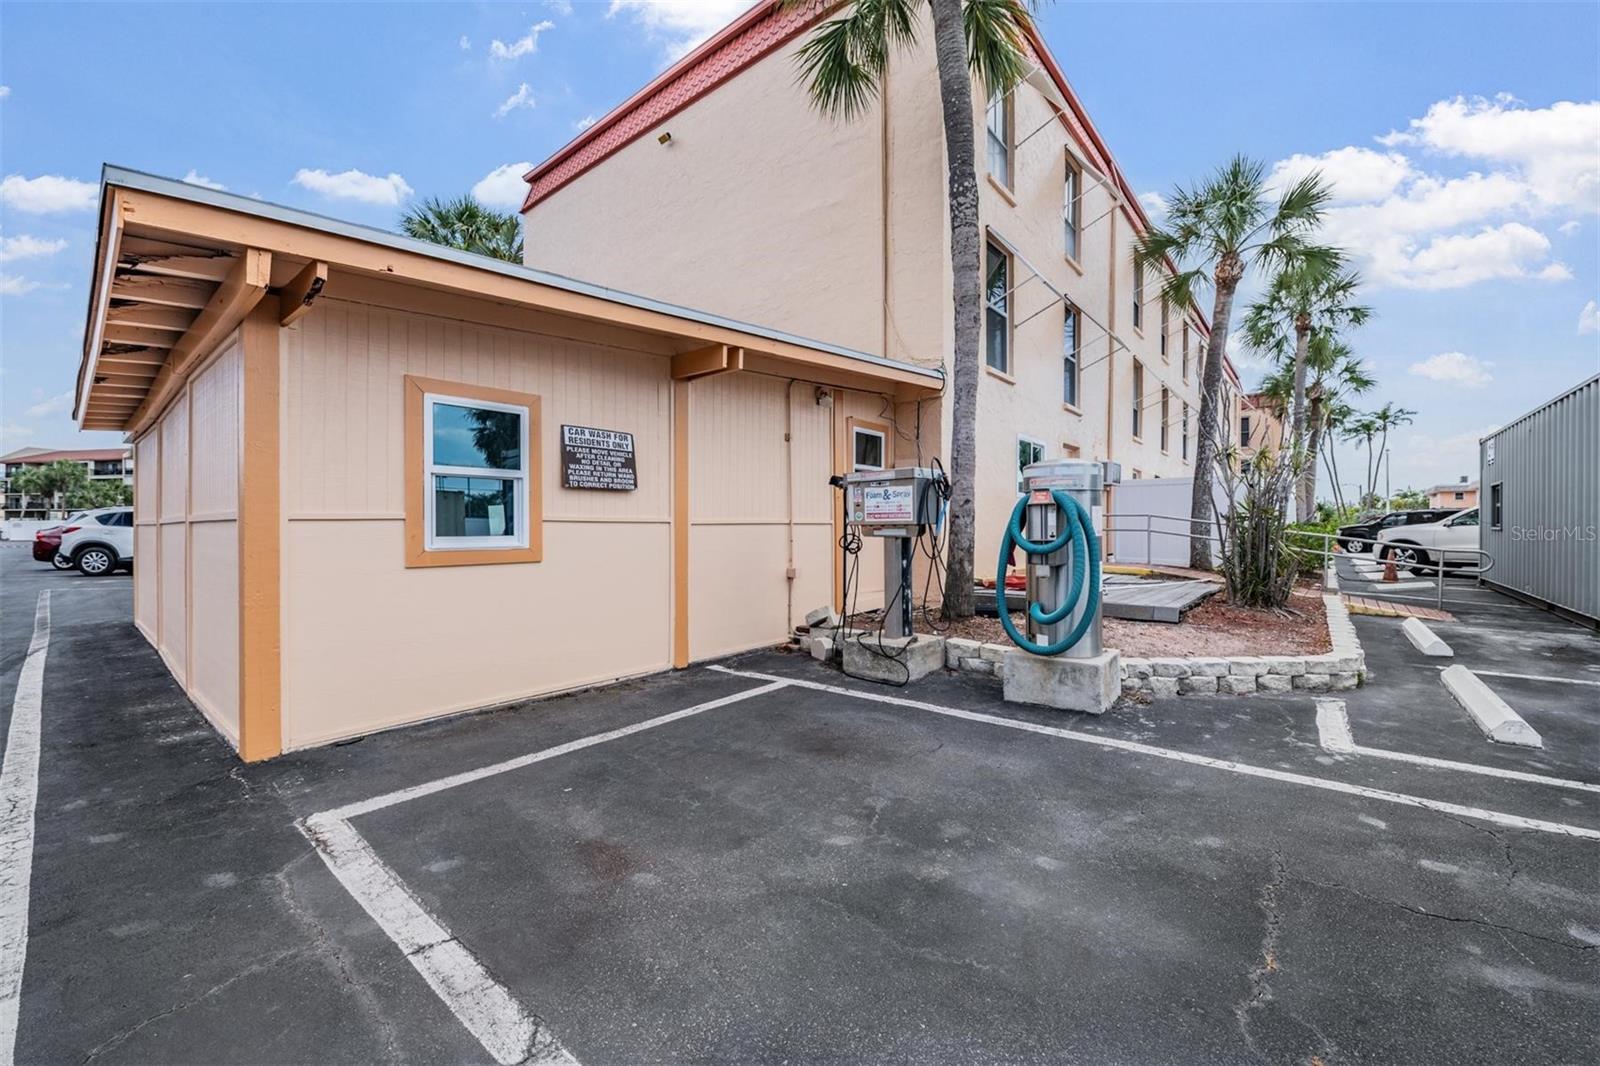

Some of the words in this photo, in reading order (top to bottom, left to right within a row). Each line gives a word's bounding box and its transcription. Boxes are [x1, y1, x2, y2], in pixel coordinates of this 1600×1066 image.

[568, 428, 586, 437] CAR
[588, 431, 611, 440] WASH
[569, 437, 610, 448] RESIDENTS
[883, 489, 891, 500] &
